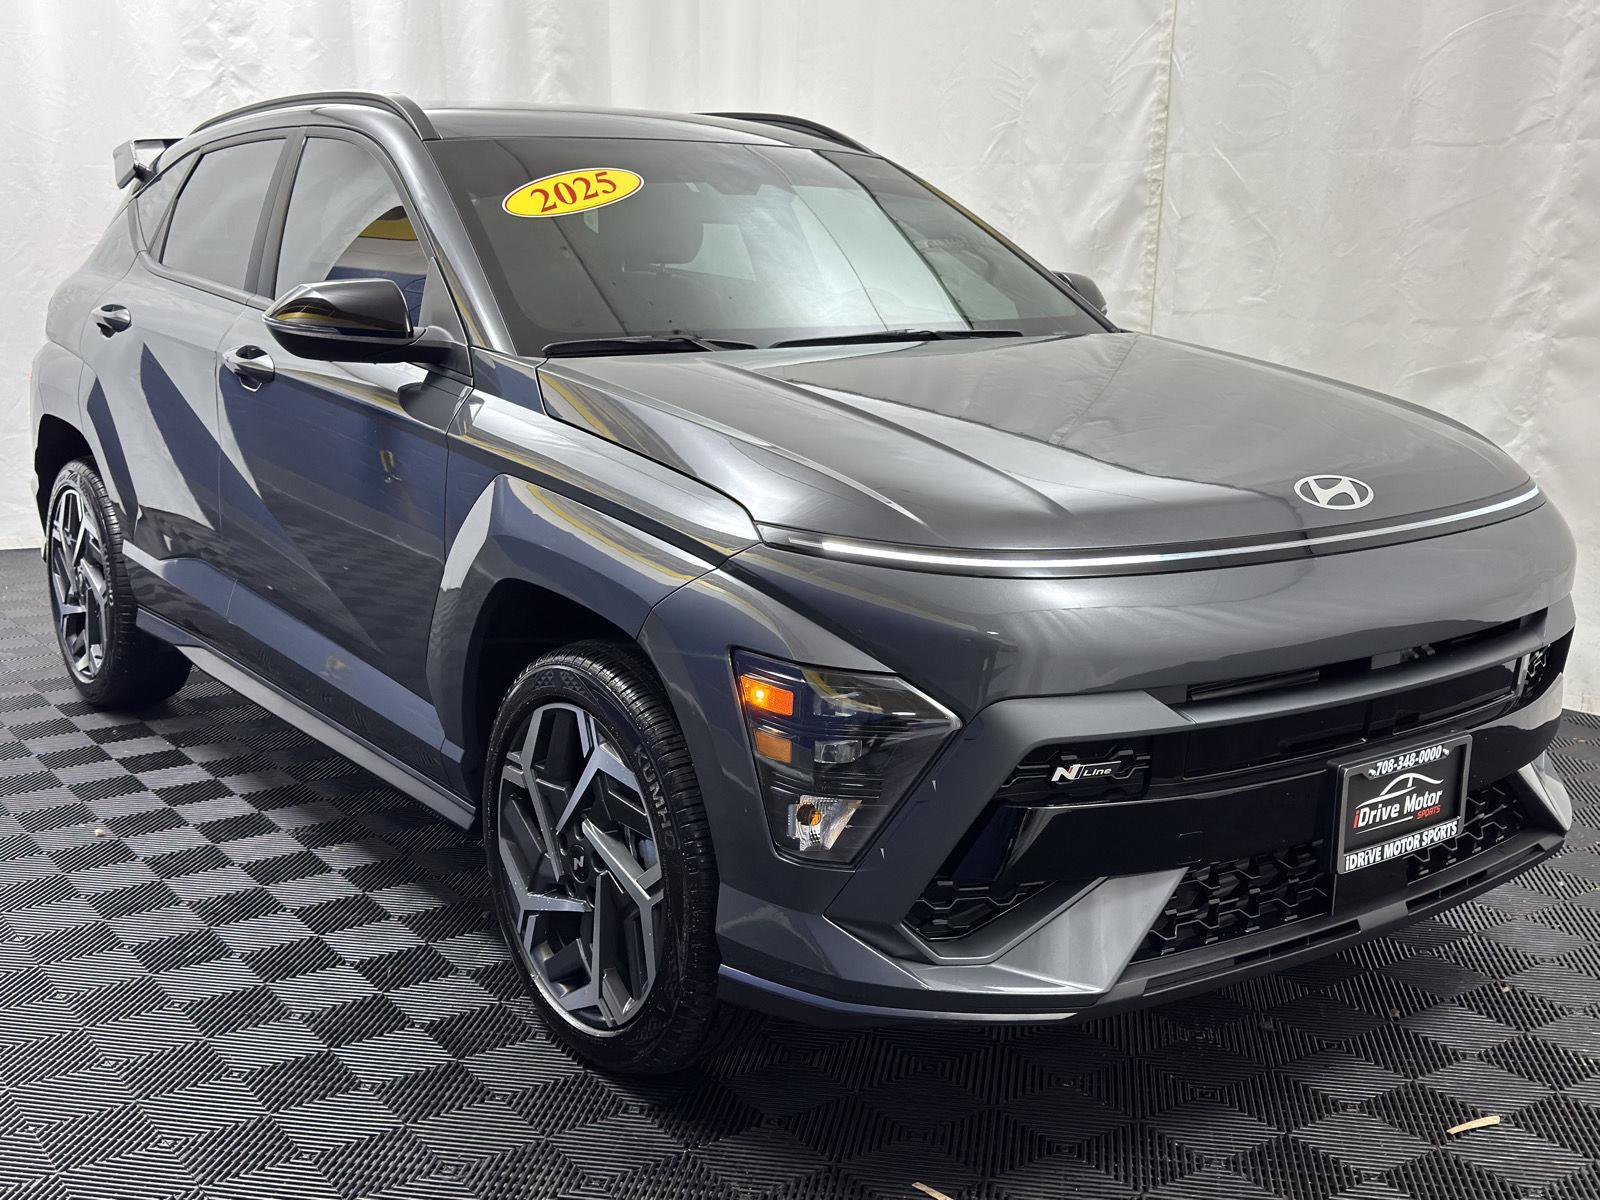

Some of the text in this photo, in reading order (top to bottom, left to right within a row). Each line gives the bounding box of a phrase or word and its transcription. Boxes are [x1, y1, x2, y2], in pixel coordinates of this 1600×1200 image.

[531, 171, 616, 212] 2025
[1051, 764, 1111, 781] N Line
[1376, 745, 1442, 776] 708-348-0000
[1353, 790, 1443, 829] iDrive Motor
[1416, 805, 1441, 820] SPORTS
[1383, 834, 1420, 859] MOTOR
[1422, 820, 1458, 846] SPORTS
